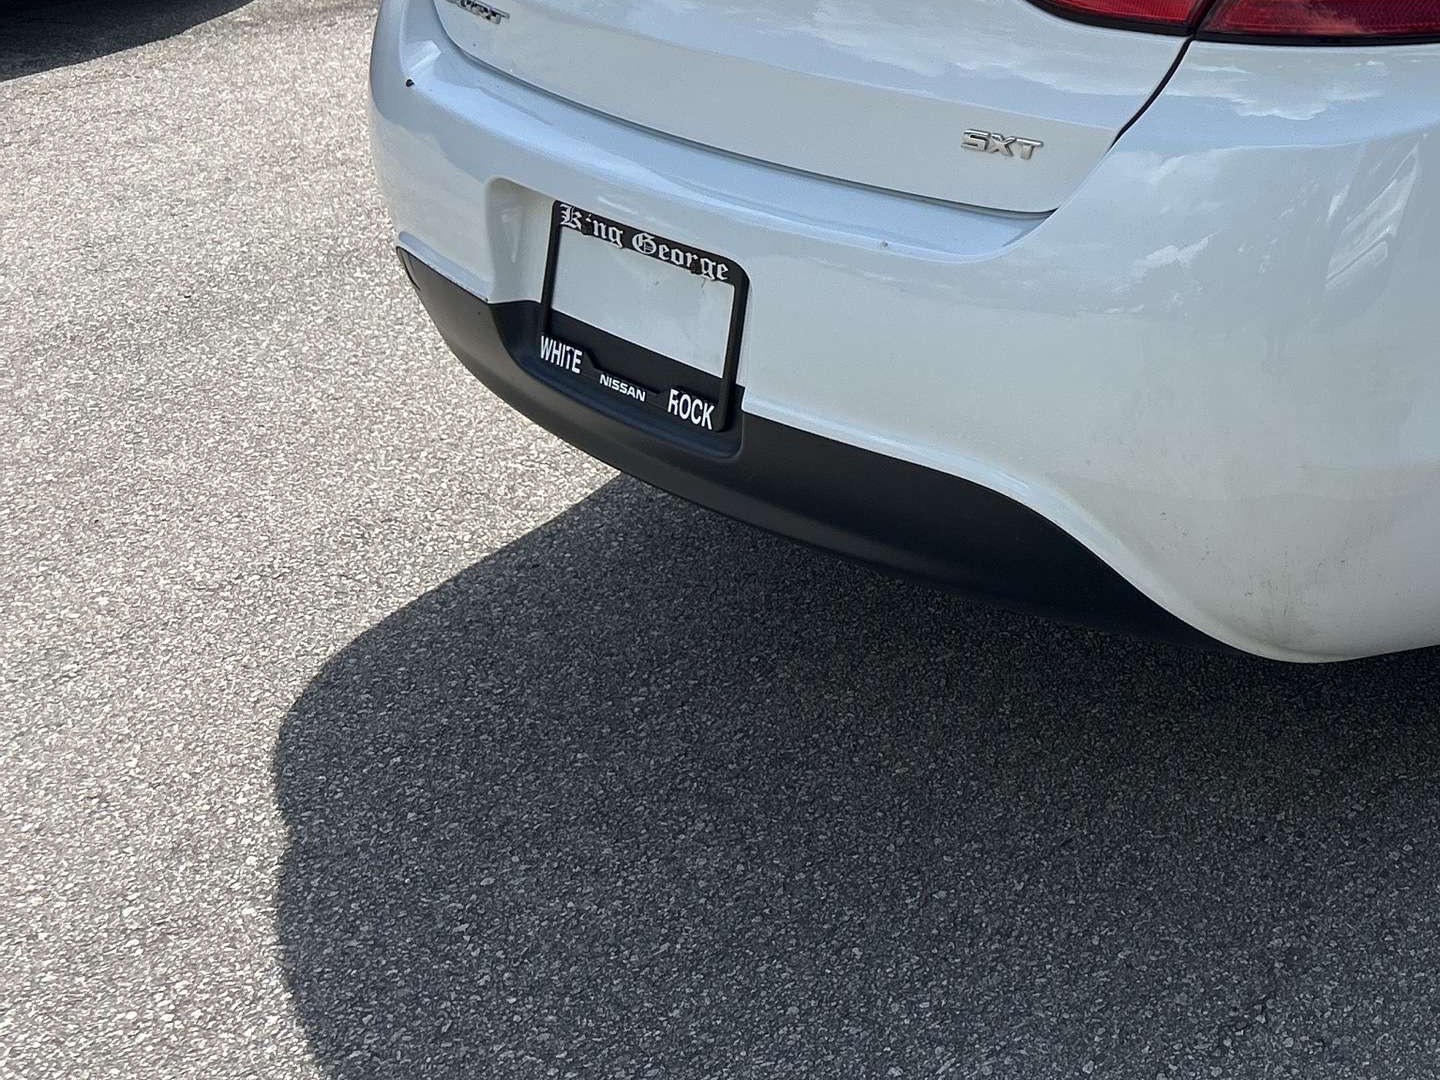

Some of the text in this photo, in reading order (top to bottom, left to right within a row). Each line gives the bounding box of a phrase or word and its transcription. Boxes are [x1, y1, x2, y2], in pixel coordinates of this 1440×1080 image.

[960, 128, 1044, 160] SXT
[631, 231, 729, 281] George
[540, 335, 715, 430] WHITE NISSAN ROCK
